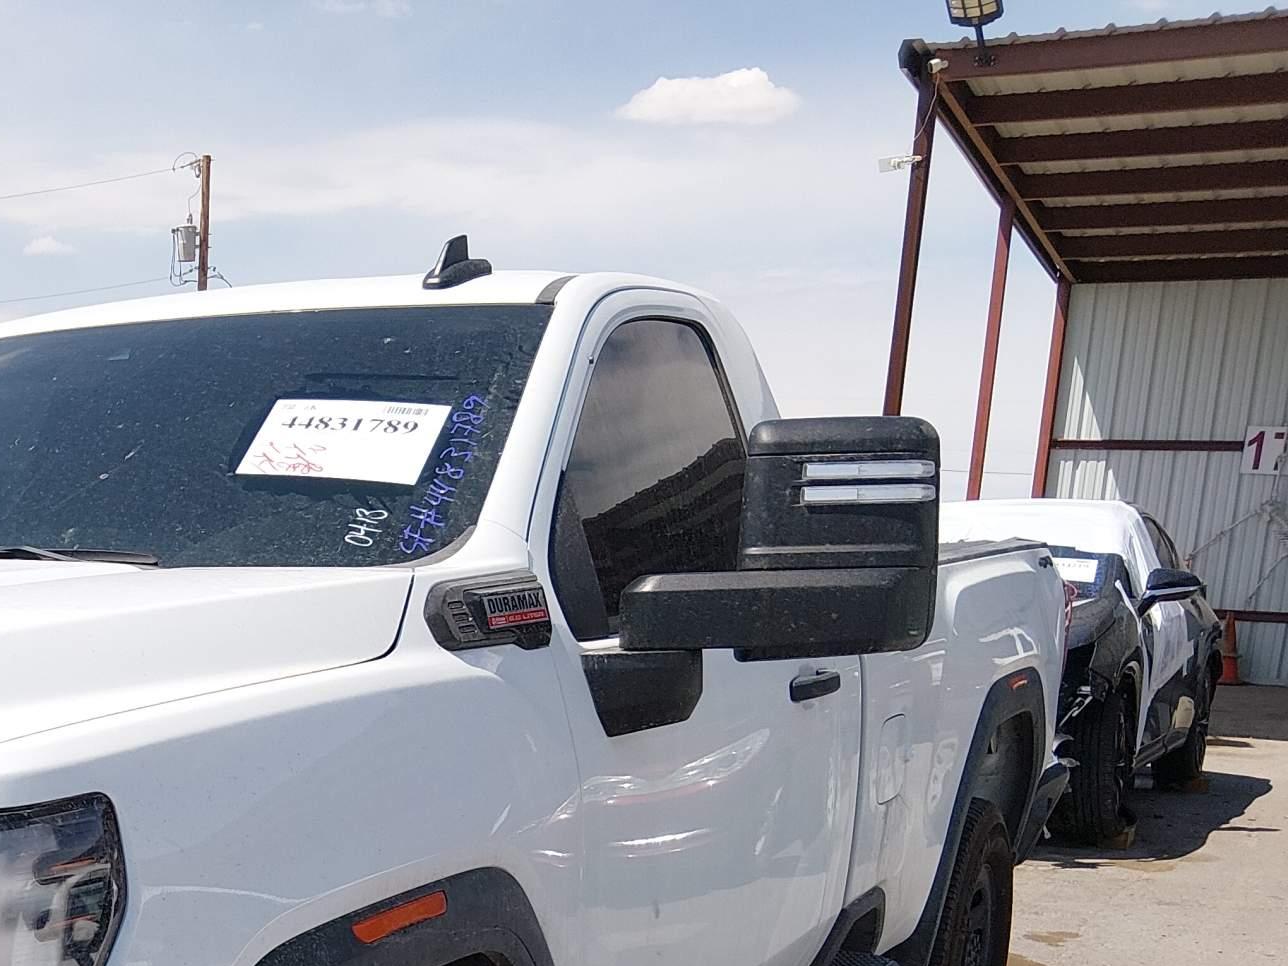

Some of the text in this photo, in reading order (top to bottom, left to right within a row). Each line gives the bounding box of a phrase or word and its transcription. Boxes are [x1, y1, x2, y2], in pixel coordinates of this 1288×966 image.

[281, 416, 419, 434] 44831789
[344, 508, 389, 547] 0413
[487, 592, 542, 614] DURAMAX
